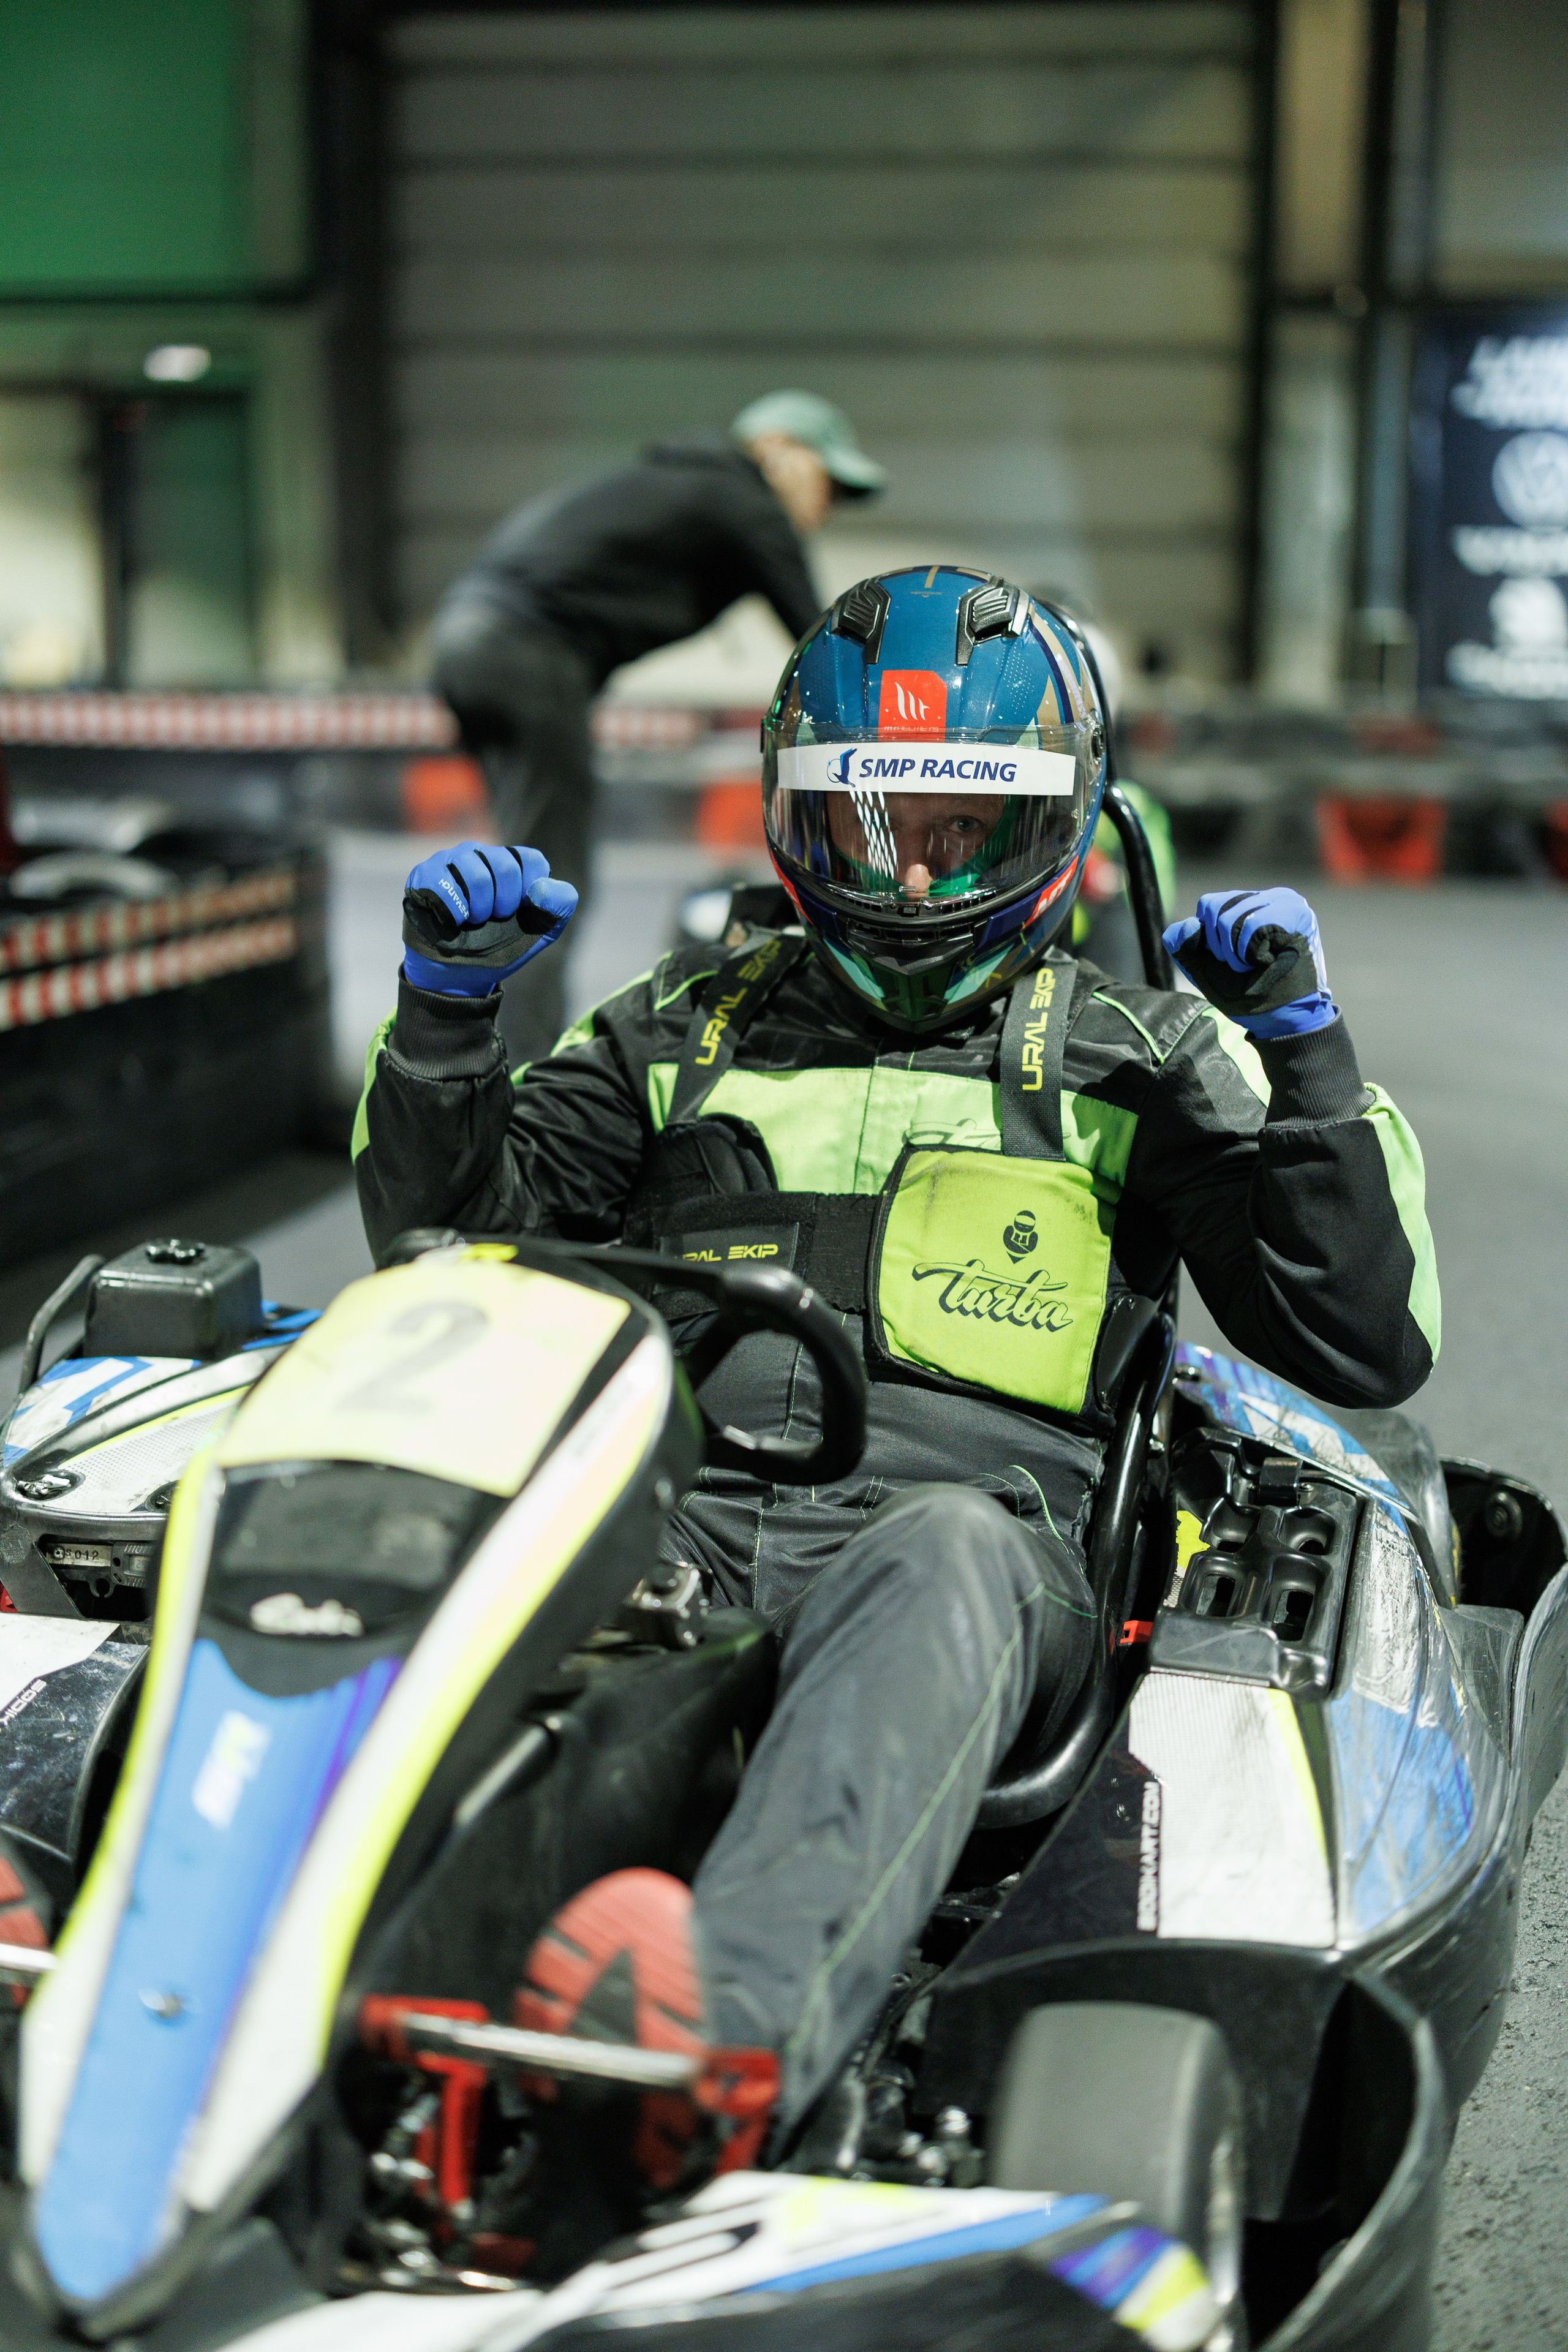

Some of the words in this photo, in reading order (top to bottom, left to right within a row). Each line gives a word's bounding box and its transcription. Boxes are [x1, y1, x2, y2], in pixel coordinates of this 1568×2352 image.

[859, 758, 916, 778] SMP
[920, 759, 1017, 782] RACING
[695, 987, 748, 1065] URAL
[737, 939, 782, 981] EKIP
[1029, 968, 1056, 1009] EKIP
[1022, 1012, 1048, 1090] URAL
[681, 1249, 722, 1262] RAL
[728, 1244, 778, 1260] EKIP
[335, 1298, 489, 1415] 2
